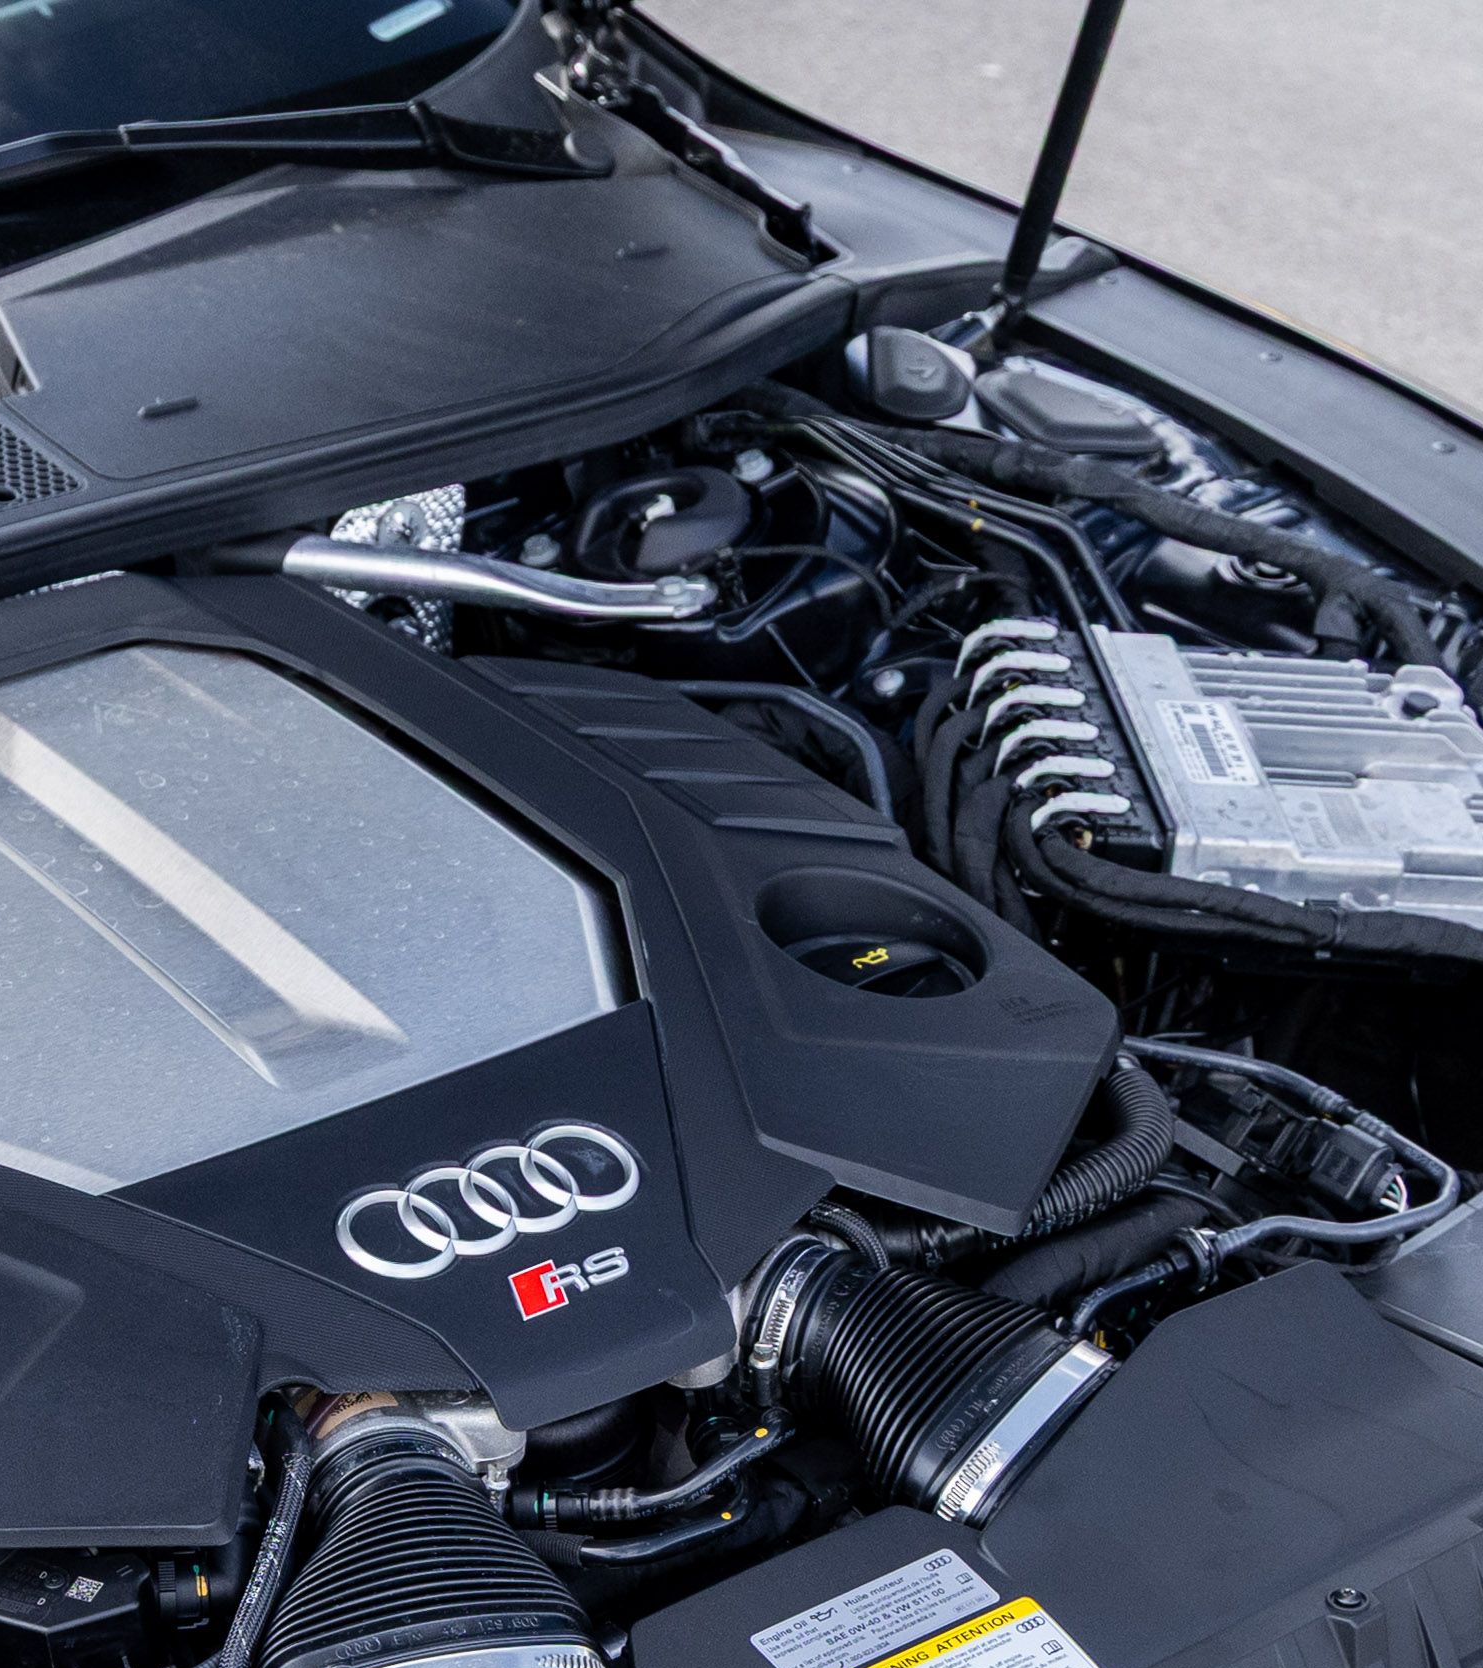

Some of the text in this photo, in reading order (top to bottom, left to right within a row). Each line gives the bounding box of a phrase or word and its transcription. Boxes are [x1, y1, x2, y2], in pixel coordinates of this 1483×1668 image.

[540, 1246, 630, 1304] RS
[843, 1577, 903, 1606] Huile moteur
[759, 1620, 807, 1645] Engine Oil
[825, 1631, 848, 1645] SAE
[848, 1617, 880, 1635] 0W-40
[891, 1602, 910, 1614] VW
[911, 1594, 930, 1606] 511
[931, 1587, 945, 1597] 00
[936, 1612, 1014, 1652] ATTENTION
